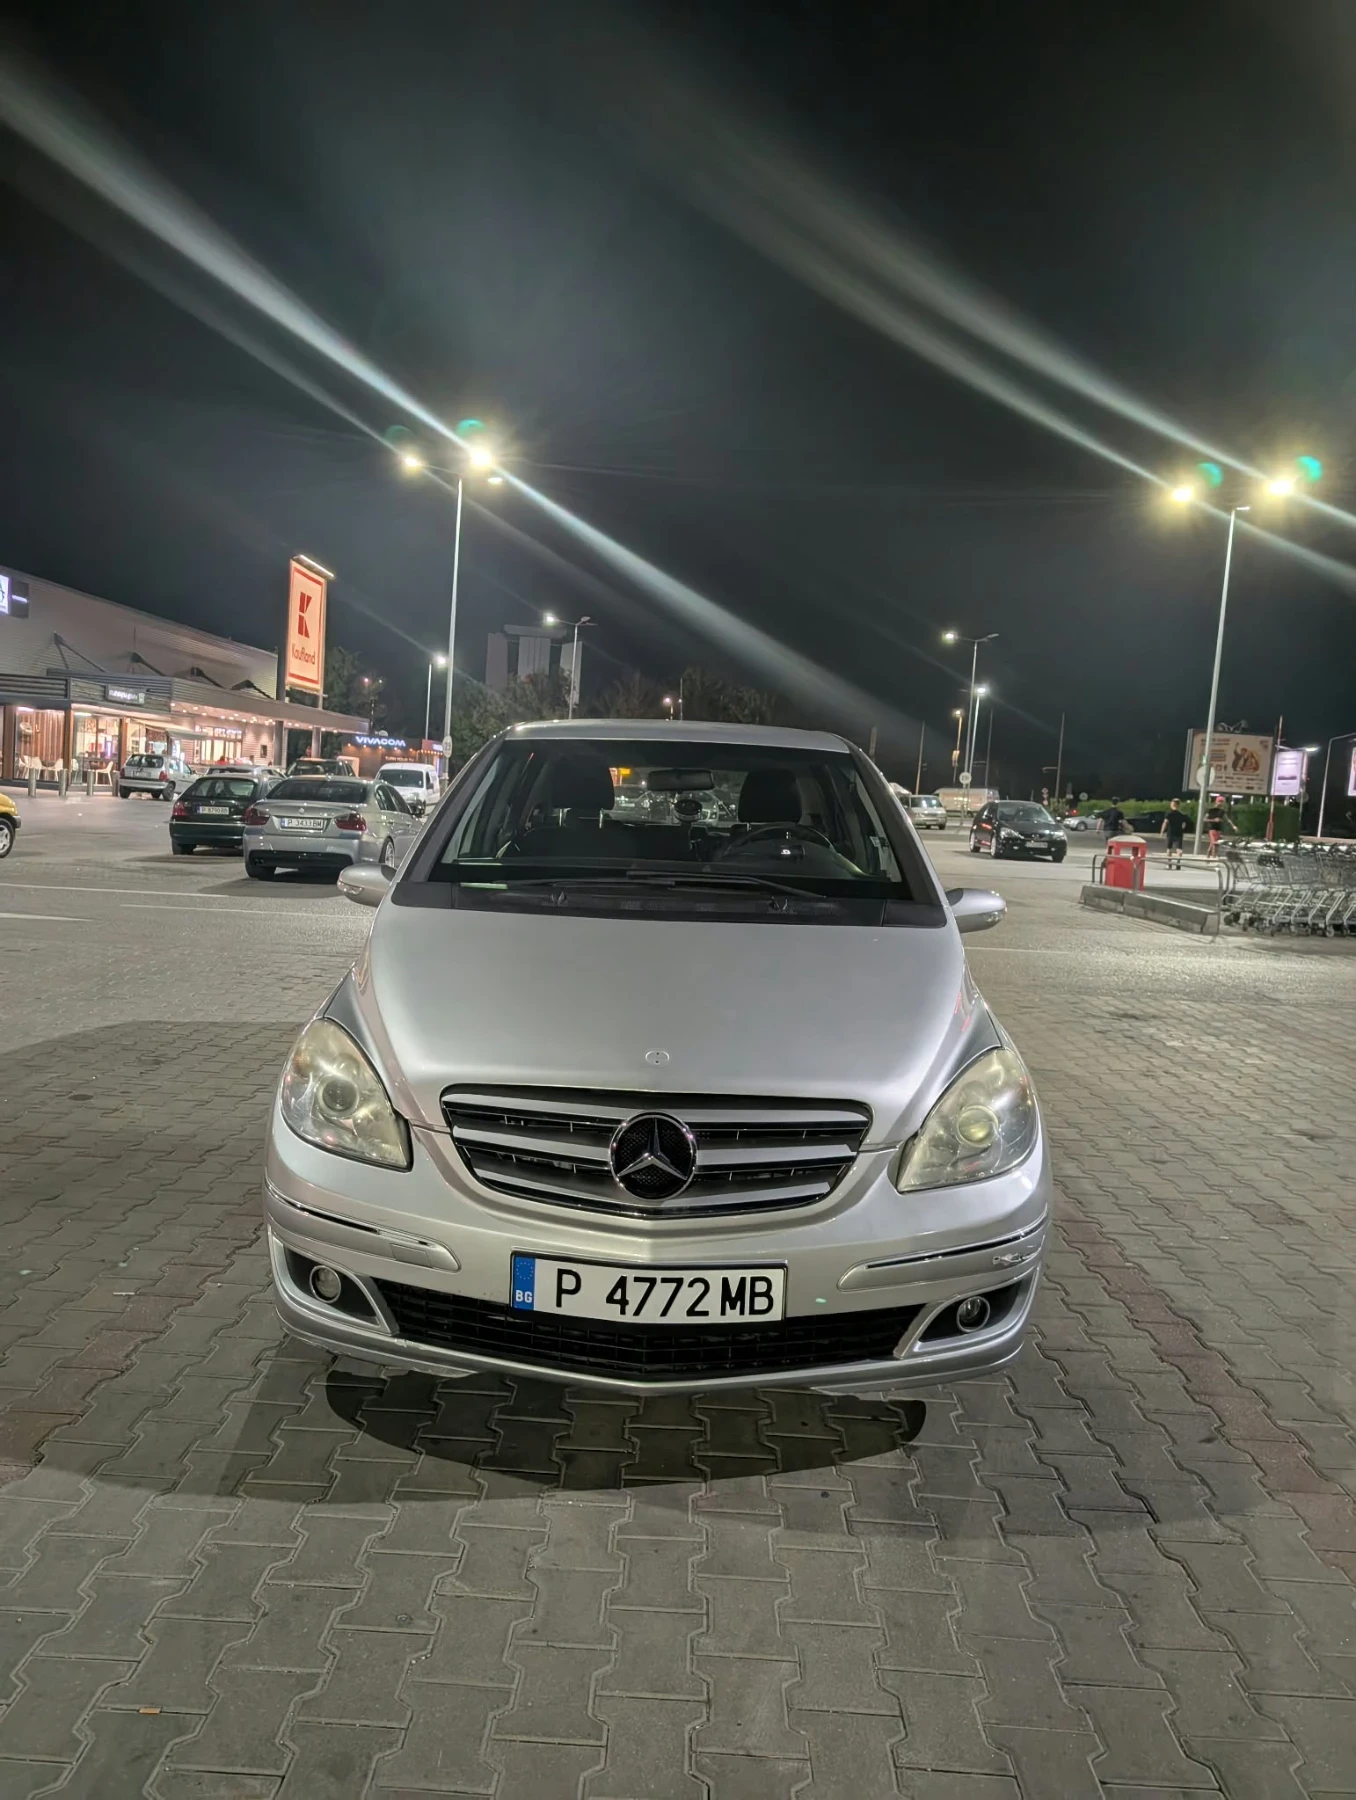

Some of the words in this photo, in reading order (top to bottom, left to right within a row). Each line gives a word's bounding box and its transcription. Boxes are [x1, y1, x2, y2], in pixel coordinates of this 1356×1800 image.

[298, 591, 312, 639] K
[291, 644, 316, 665] Kaufland
[355, 736, 406, 747] VIVACOM
[288, 819, 292, 827] P
[515, 1289, 533, 1303] BG
[556, 1268, 581, 1308] P
[606, 1274, 710, 1317] 4772
[720, 1276, 774, 1316] MB
